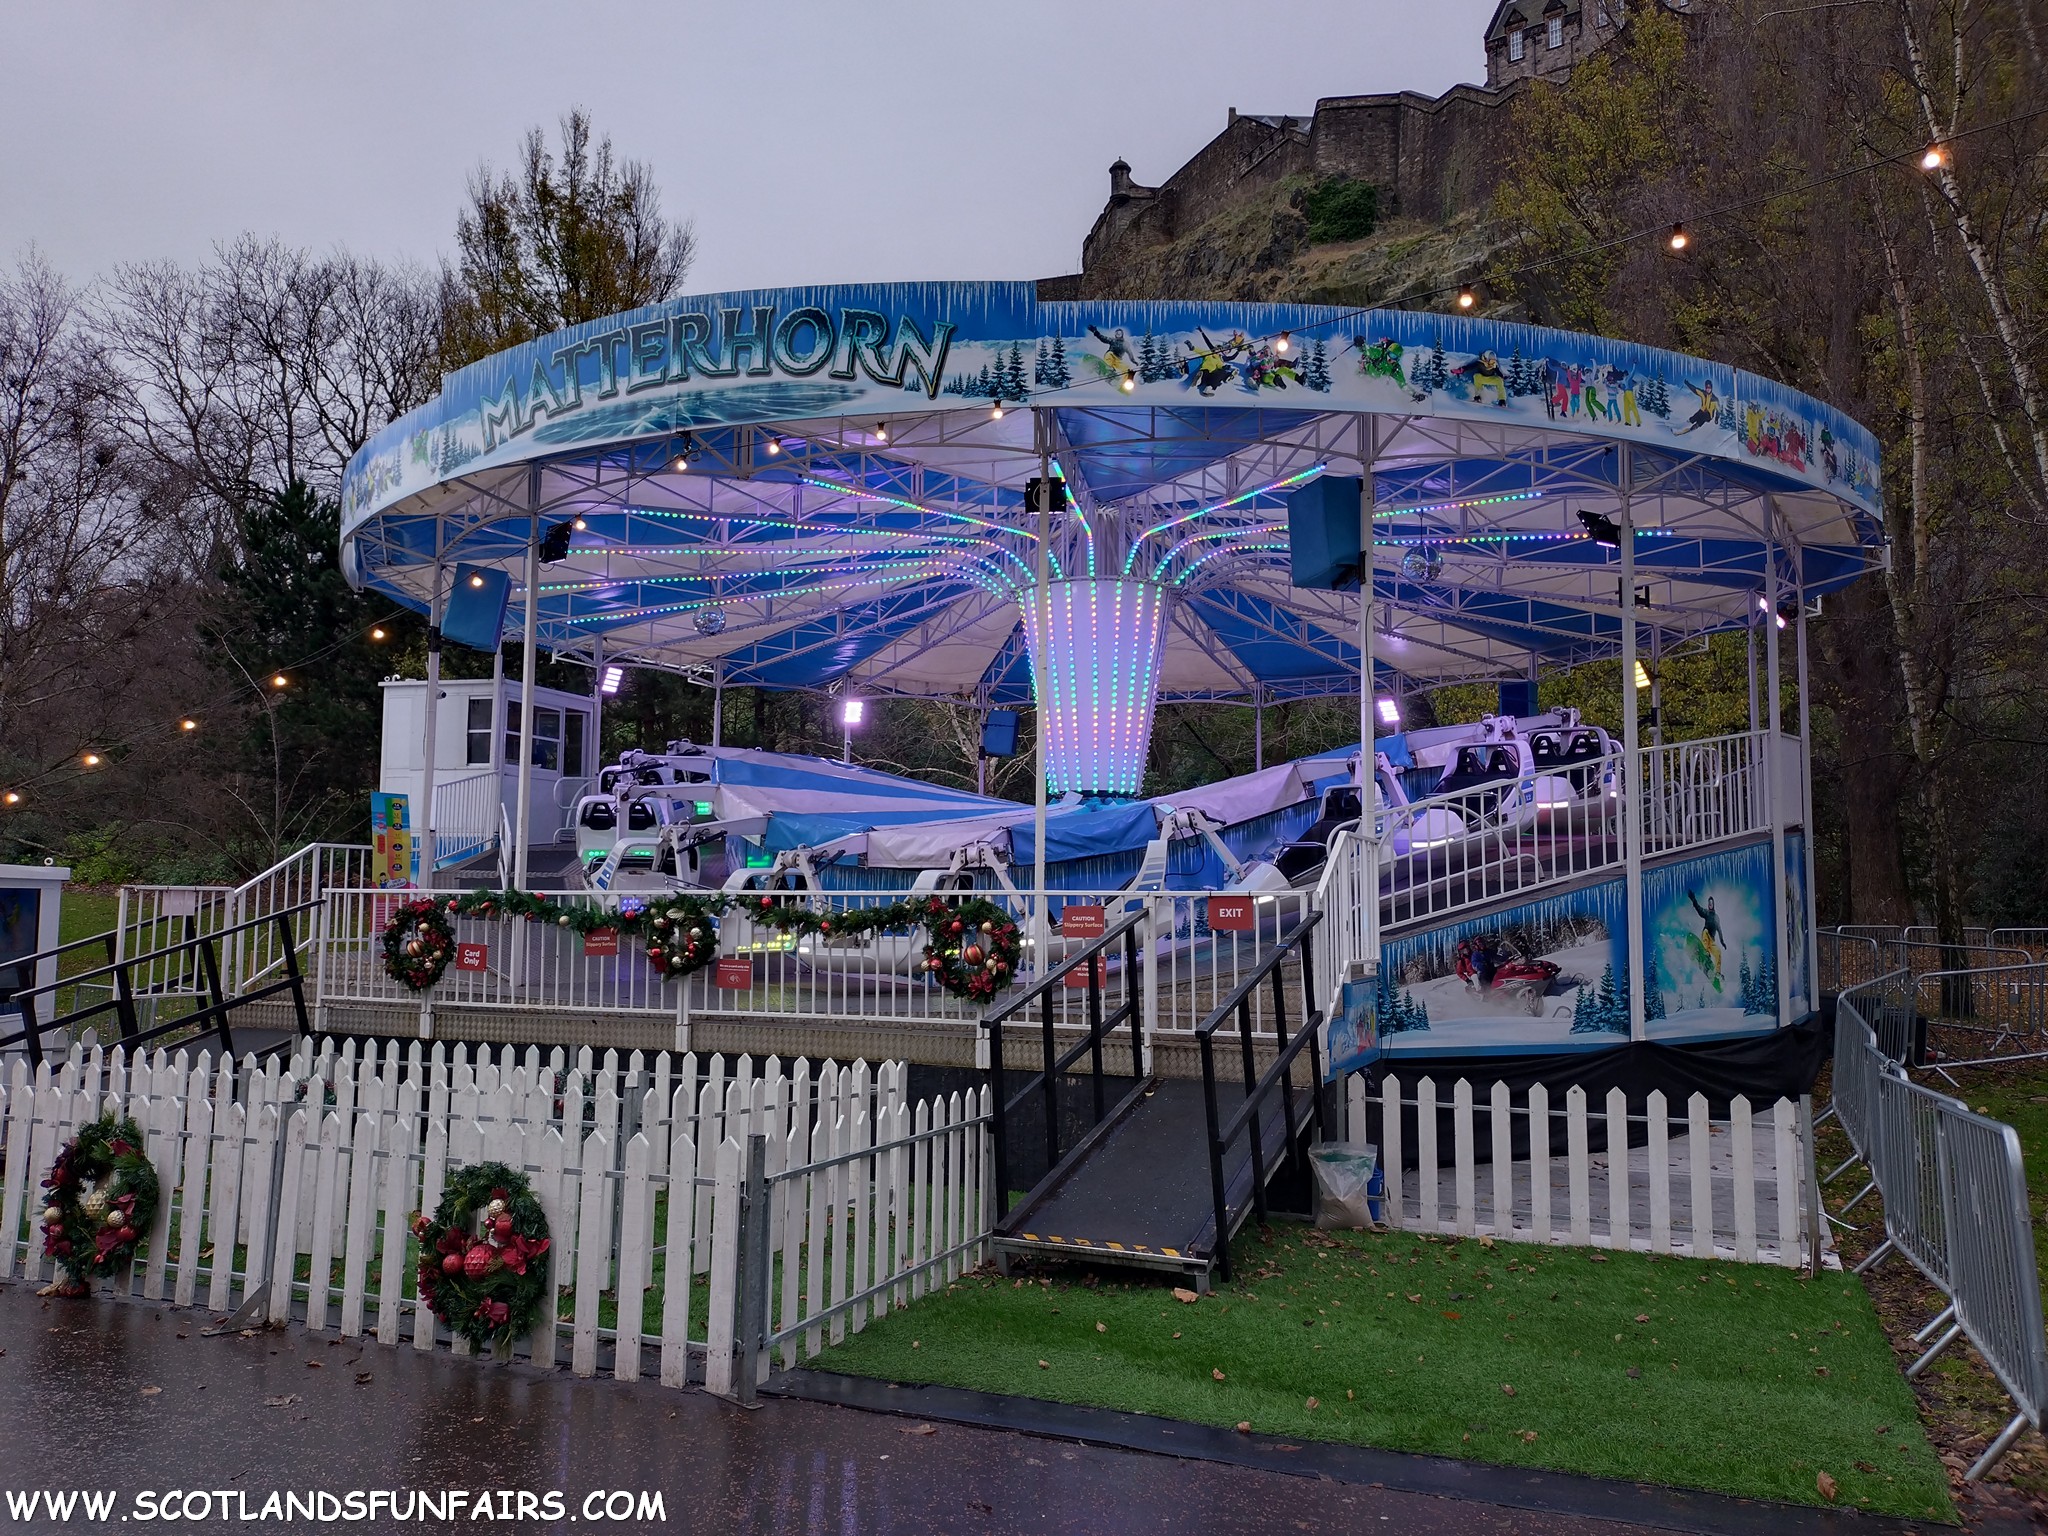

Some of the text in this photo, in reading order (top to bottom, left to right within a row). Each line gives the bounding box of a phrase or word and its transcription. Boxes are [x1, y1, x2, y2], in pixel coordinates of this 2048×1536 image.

[480, 305, 957, 454] MATTERHORN
[1219, 908, 1243, 918] EXIT
[464, 949, 480, 957] Card
[463, 957, 480, 967] Only
